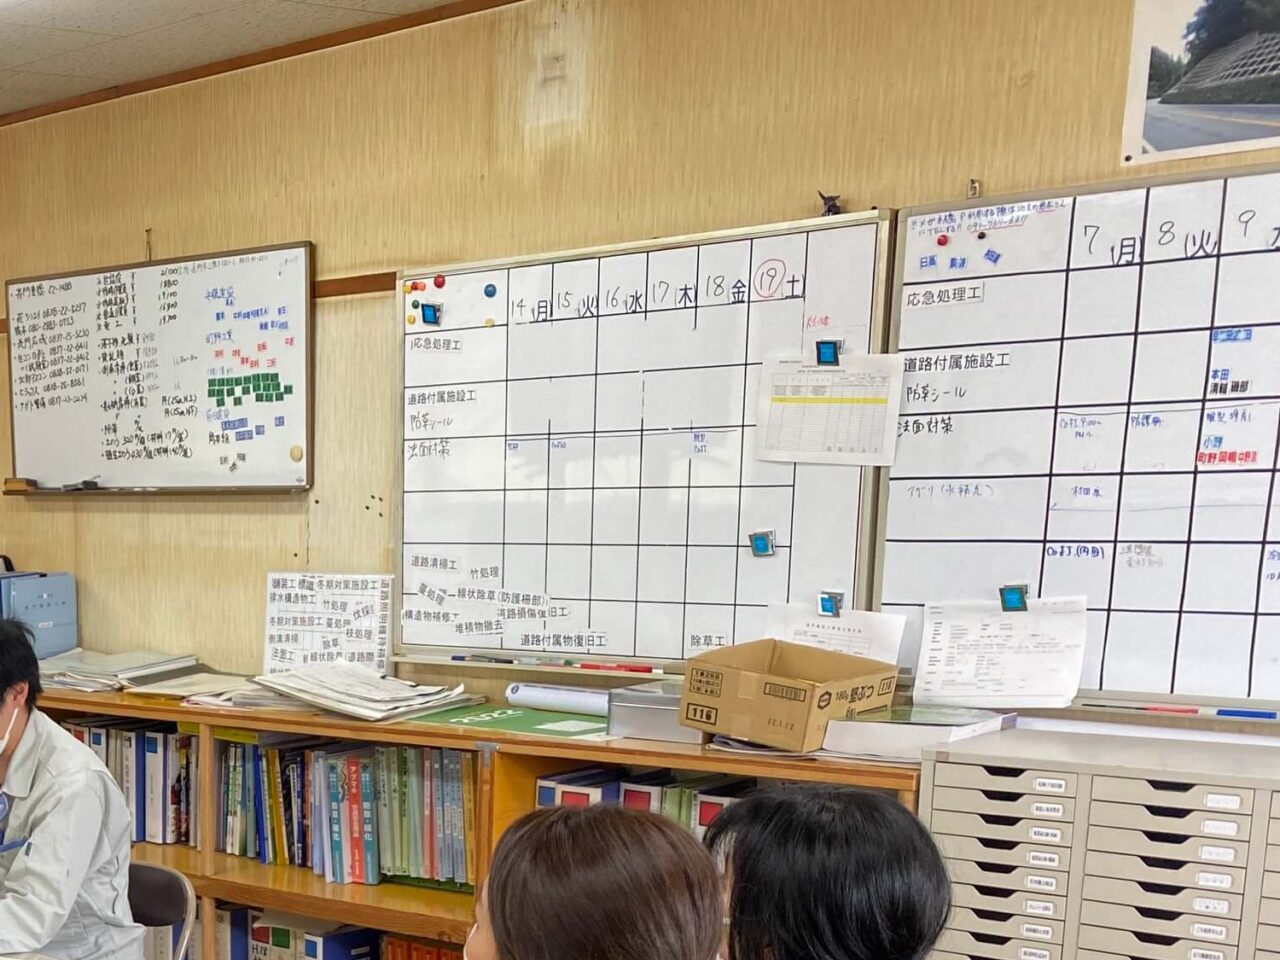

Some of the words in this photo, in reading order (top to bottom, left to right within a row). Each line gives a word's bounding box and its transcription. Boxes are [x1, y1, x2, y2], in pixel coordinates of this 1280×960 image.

[1158, 220, 1175, 245] 8
[1238, 210, 1256, 237] 9
[1084, 225, 1100, 255] 7
[706, 275, 725, 297] 18
[760, 267, 777, 291] 19
[558, 291, 573, 309] 15
[606, 286, 619, 308] 16
[653, 281, 669, 303] 17
[907, 286, 981, 307] 応急処理工
[511, 298, 526, 317] 14
[413, 337, 461, 350] 応急処理工
[904, 352, 1010, 373] 道路付属施設工
[408, 390, 476, 405] 道路付属施設工
[906, 382, 967, 403] 防草シール
[470, 566, 500, 580] 竹処理
[520, 634, 607, 647] 道路付属物復旧工
[690, 635, 725, 647] 除草工
[692, 707, 713, 721] 116
